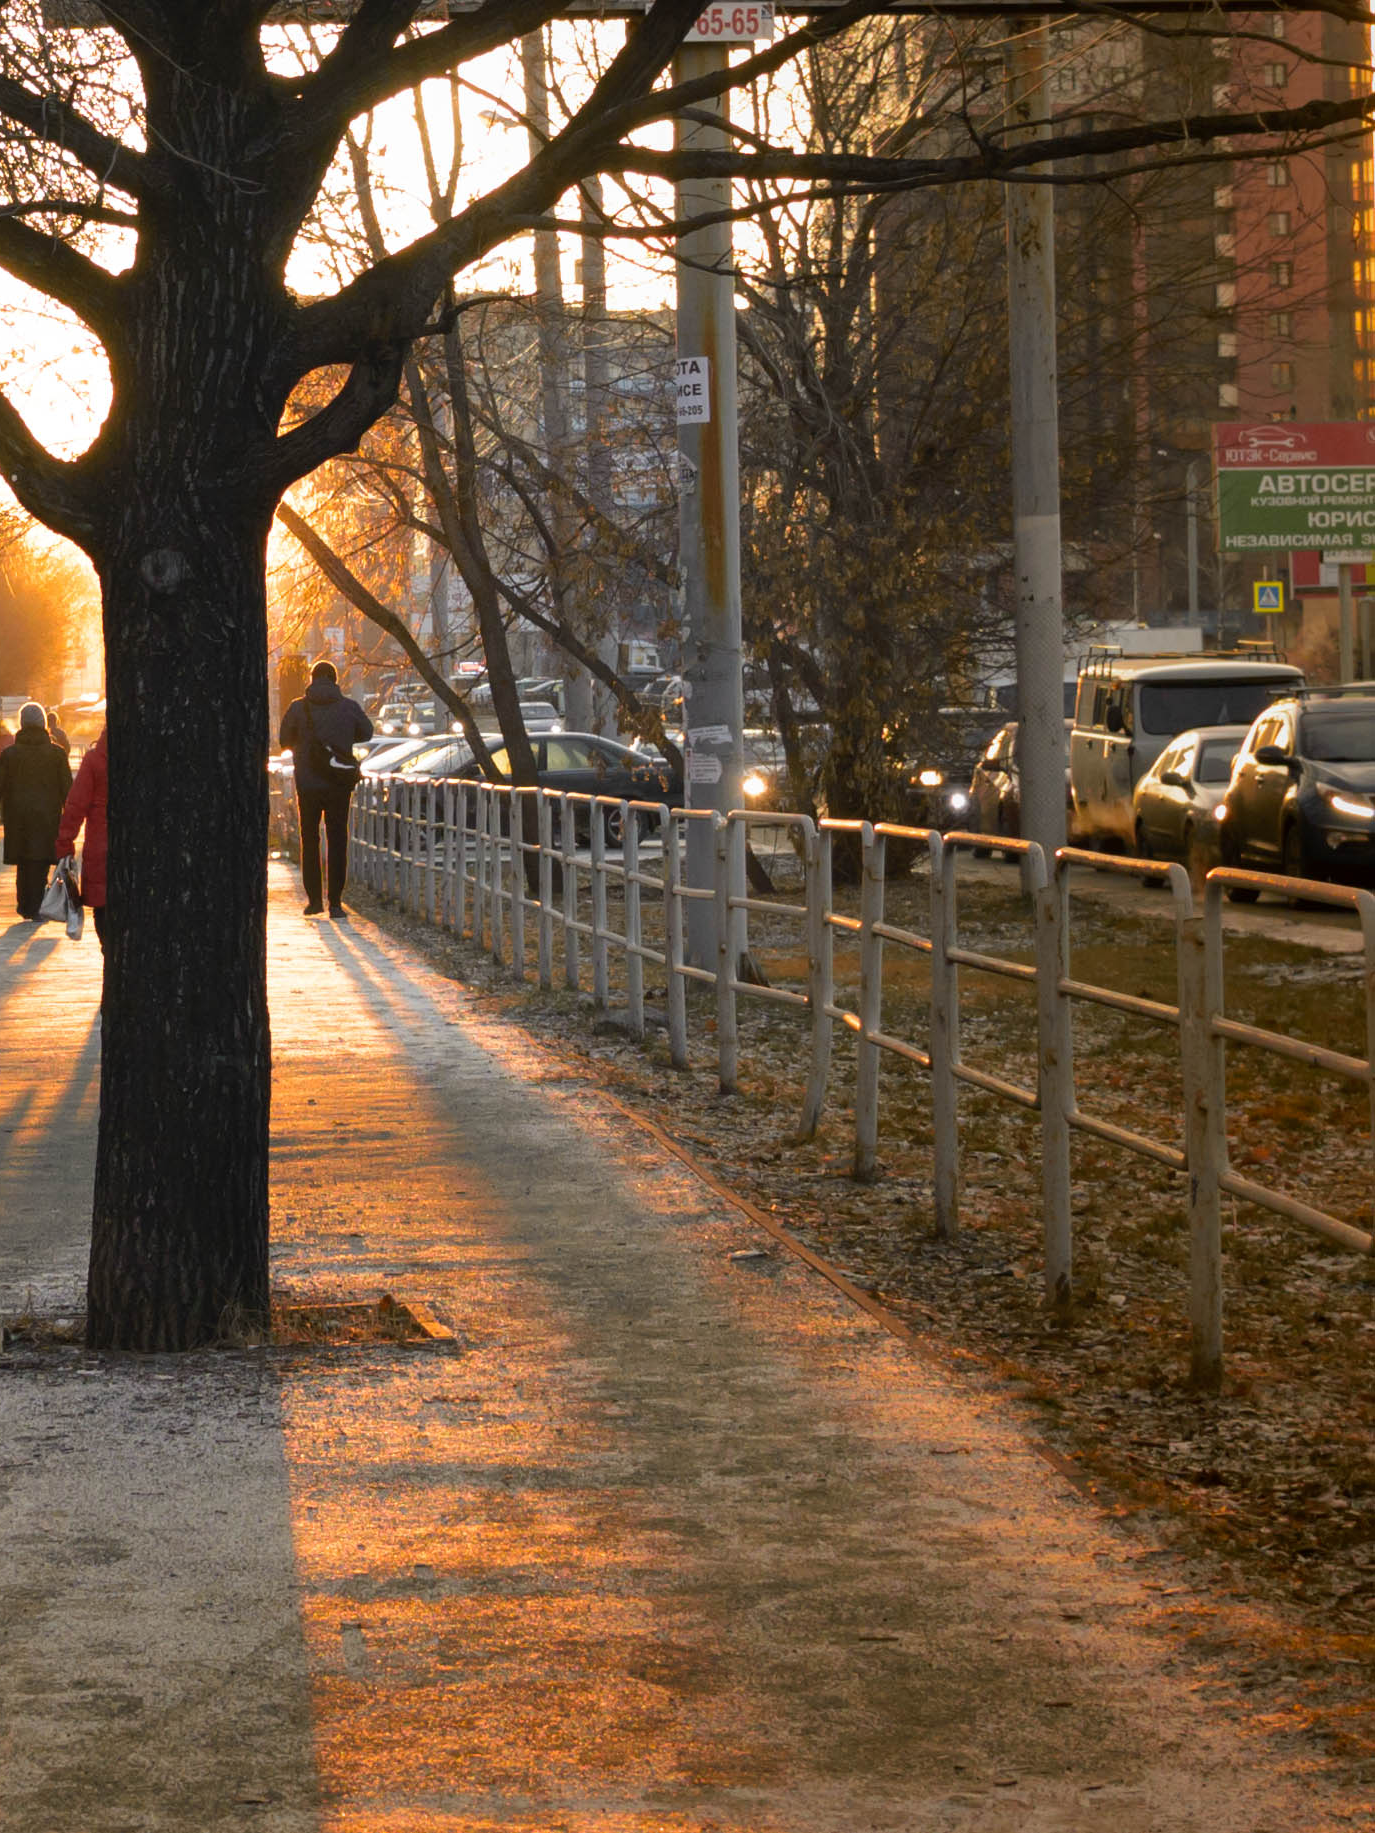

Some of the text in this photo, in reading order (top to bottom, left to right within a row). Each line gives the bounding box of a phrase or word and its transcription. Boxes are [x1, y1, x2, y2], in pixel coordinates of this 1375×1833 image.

[1250, 496, 1321, 507] КУЗОВНОЙ
[1308, 511, 1375, 528] ЮРИС
[1225, 534, 1353, 547] НЕЗАВИСИМАЯ
